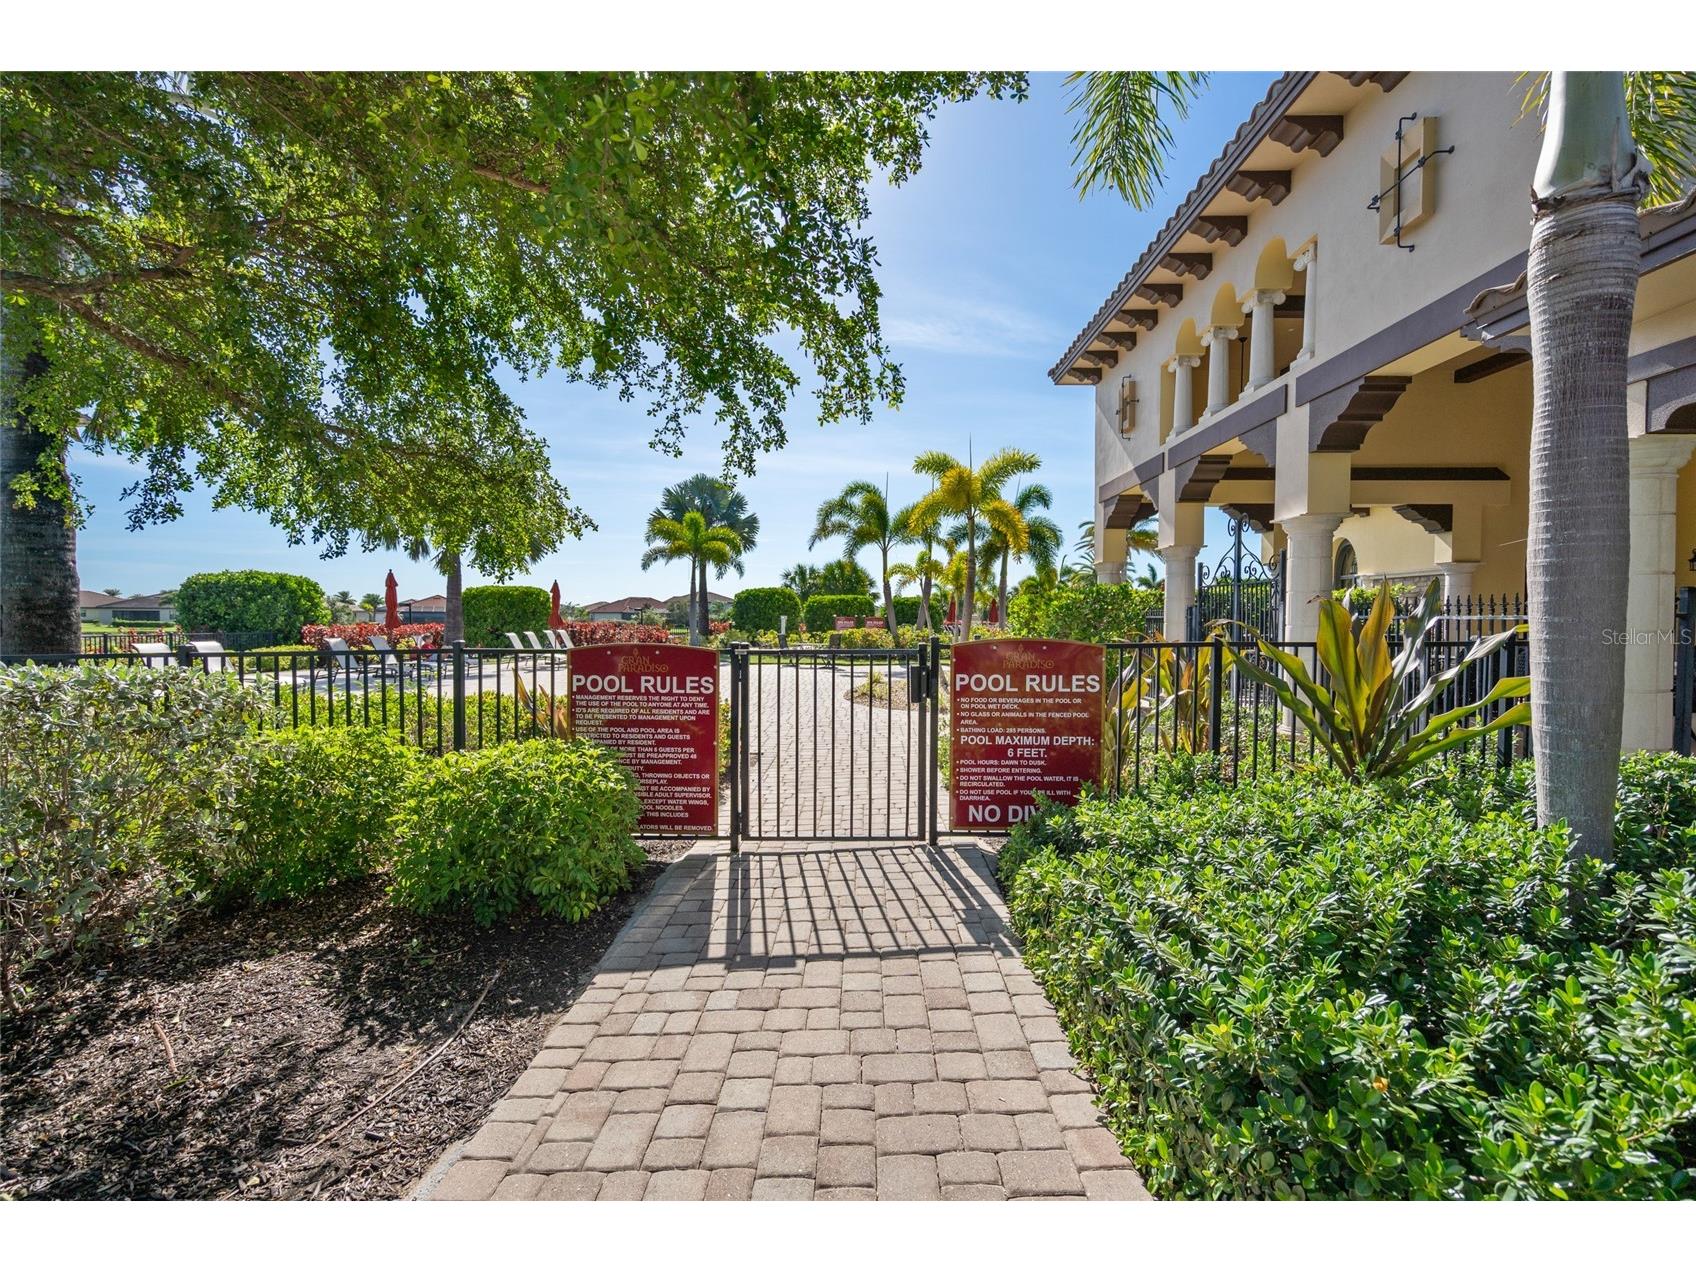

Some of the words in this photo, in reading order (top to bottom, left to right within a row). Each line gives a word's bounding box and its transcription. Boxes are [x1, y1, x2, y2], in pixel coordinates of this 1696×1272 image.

[622, 656, 649, 664] GRAN
[619, 664, 668, 673] PARADISO
[572, 675, 634, 693] POOL
[641, 676, 714, 694] RULES
[956, 674, 1018, 692] POOL
[1026, 674, 1100, 693] RULES
[960, 736, 992, 745] POOL
[995, 736, 1050, 745] MAXIMUM
[1053, 737, 1094, 746] DEPTH:
[1008, 749, 1013, 757] 6
[1017, 749, 1047, 757] FEET.
[969, 805, 1001, 822] NO
